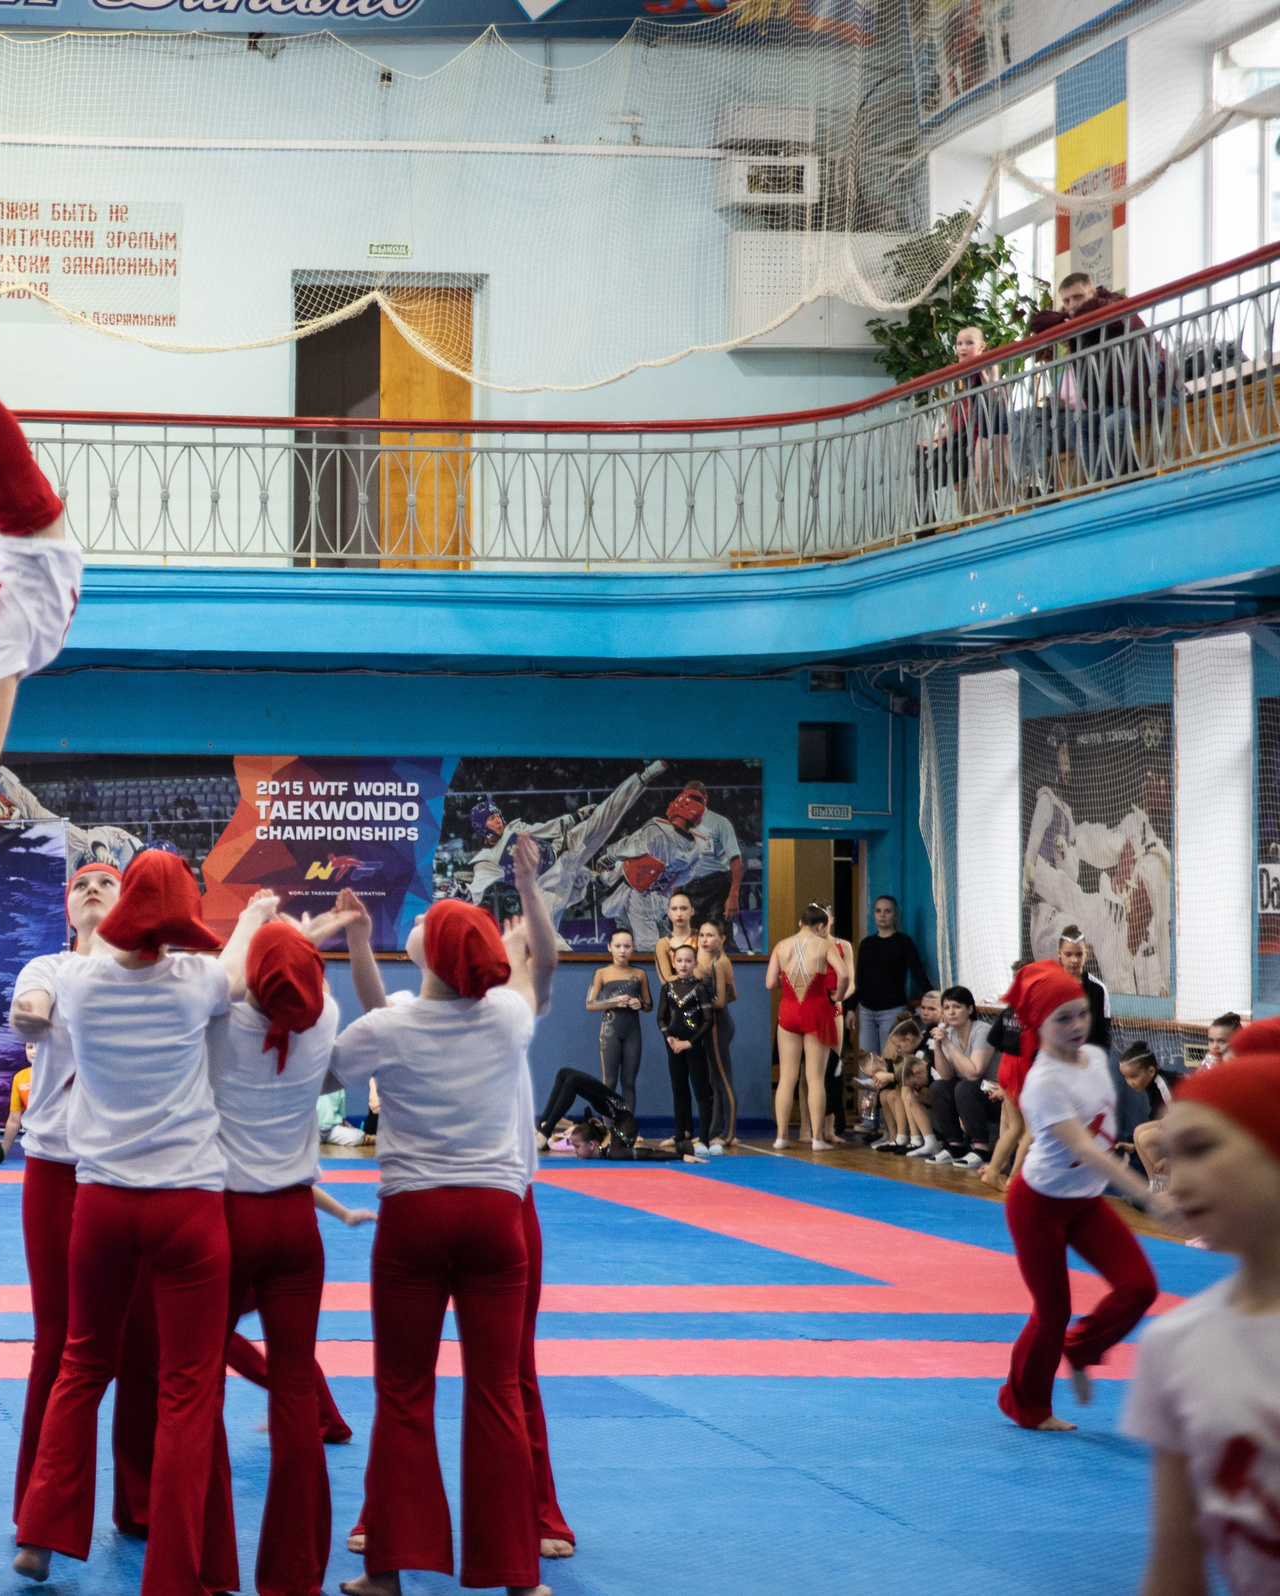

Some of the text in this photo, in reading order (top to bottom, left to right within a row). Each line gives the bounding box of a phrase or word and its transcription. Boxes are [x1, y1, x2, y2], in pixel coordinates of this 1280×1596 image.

[256, 781, 420, 797] 2015 WTF WORLD
[255, 800, 420, 821] TAEKWONDO
[813, 807, 848, 818] ВЫХОД
[255, 826, 419, 841] CHAMPIONSHIPS
[304, 853, 384, 882] WTF
